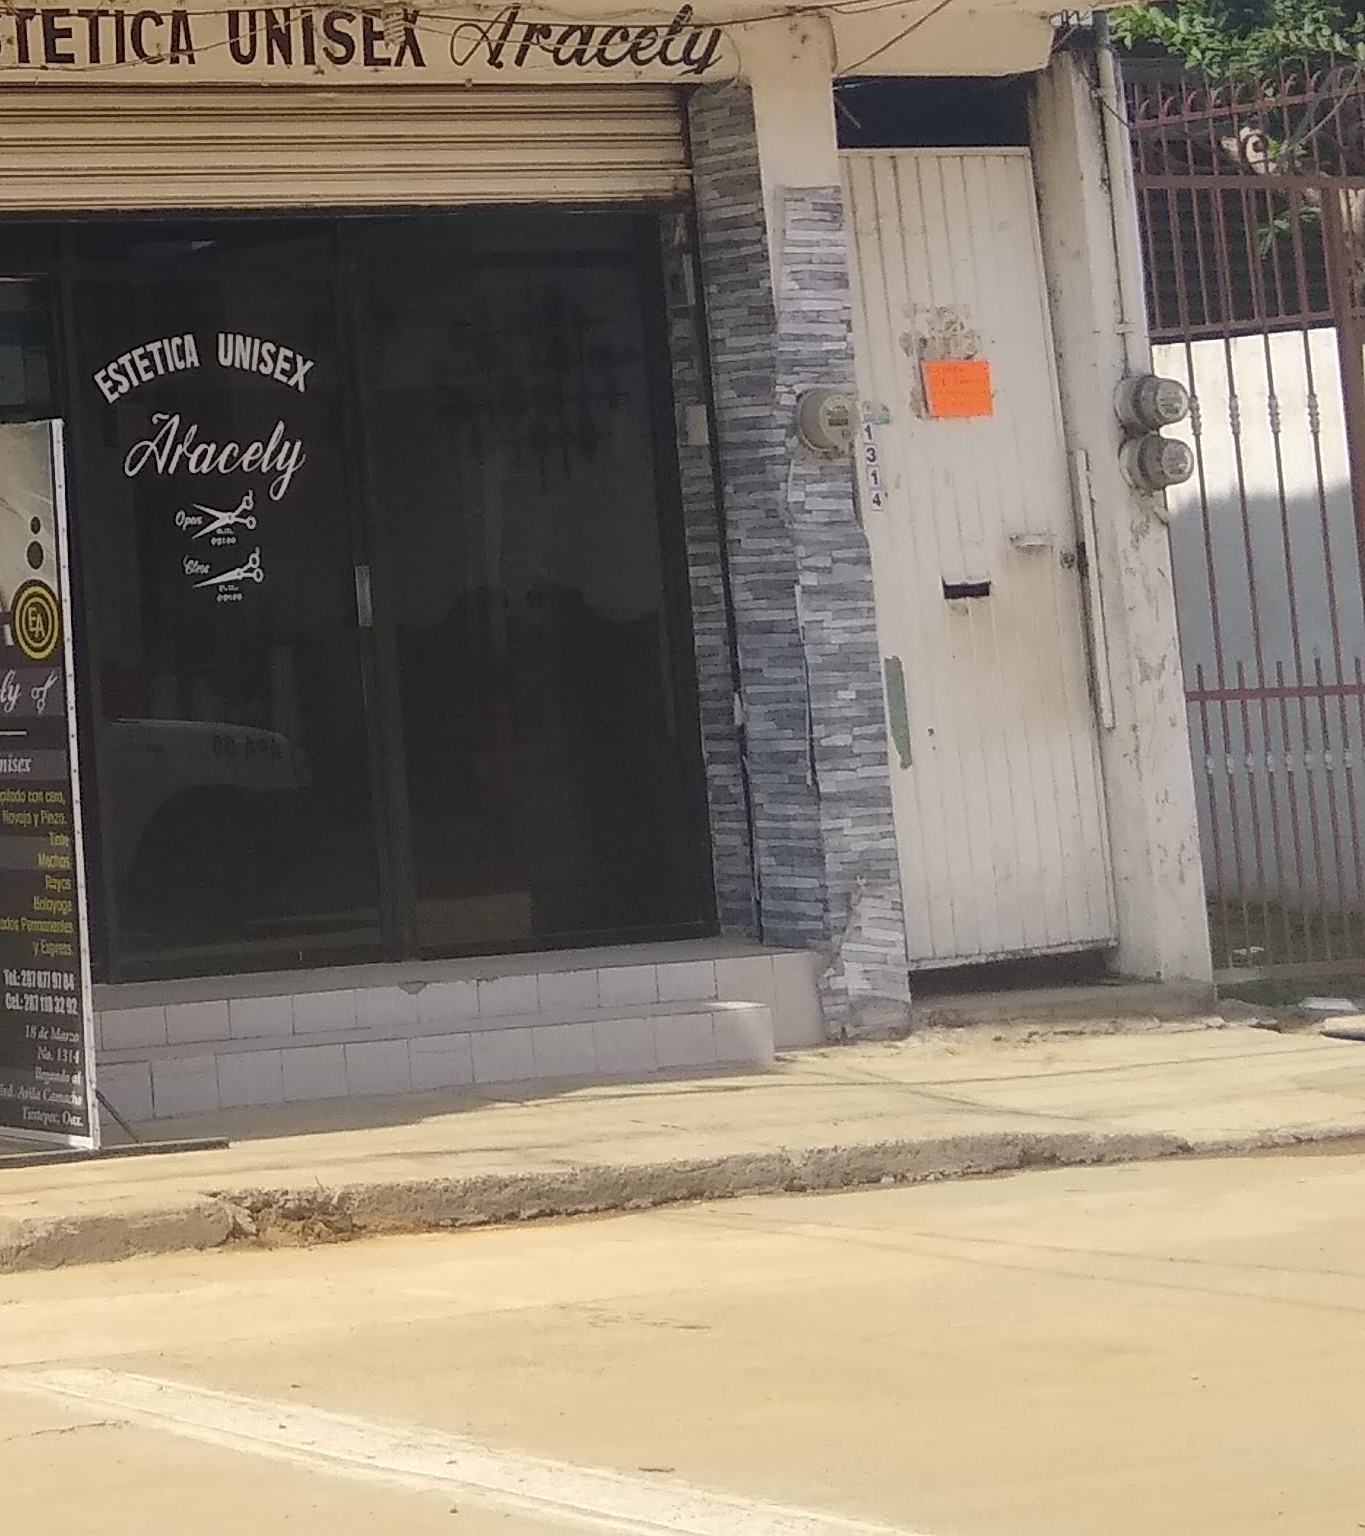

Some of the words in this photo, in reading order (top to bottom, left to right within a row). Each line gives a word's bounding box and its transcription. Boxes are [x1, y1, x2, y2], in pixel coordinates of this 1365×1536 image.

[228, 7, 427, 68] UNISEX
[449, 2, 724, 78] Aracely
[93, 333, 200, 404] ESTETICA
[217, 331, 315, 393] UNISEX
[124, 413, 307, 501] Aracely
